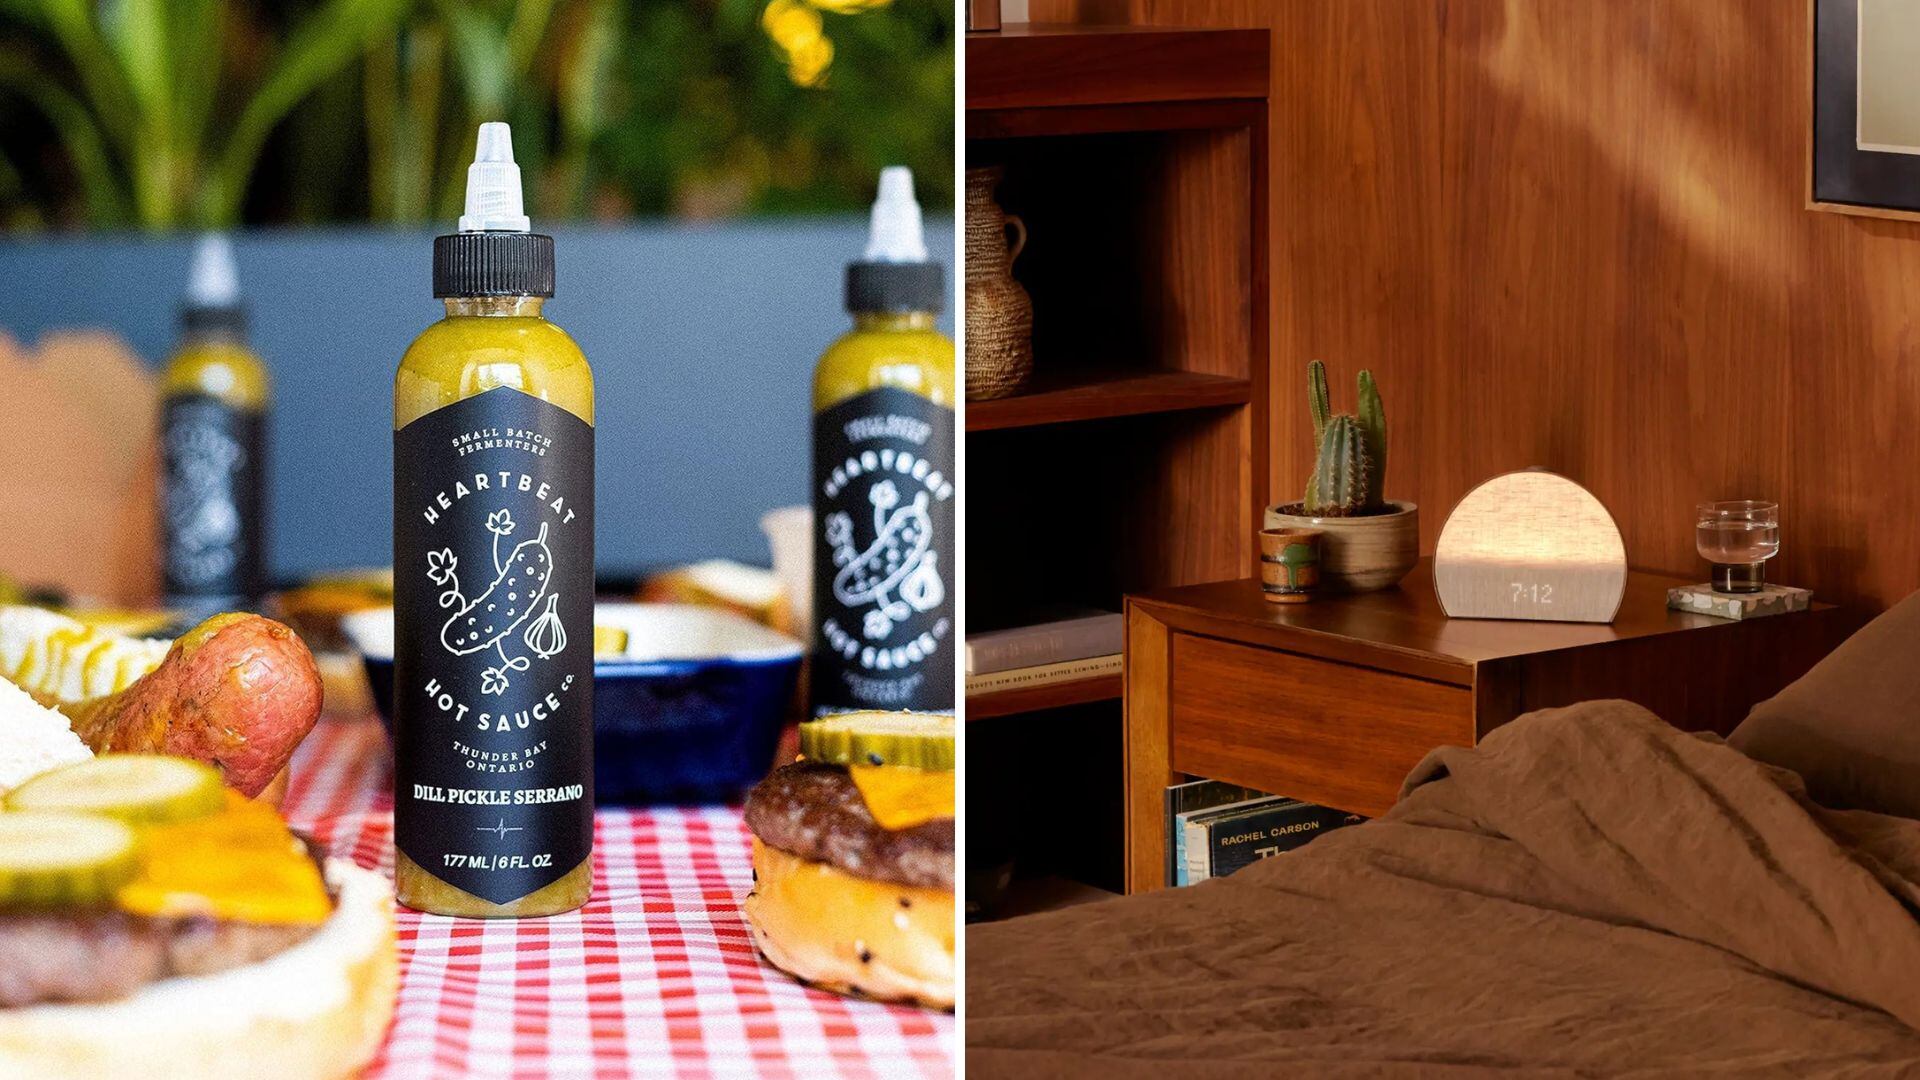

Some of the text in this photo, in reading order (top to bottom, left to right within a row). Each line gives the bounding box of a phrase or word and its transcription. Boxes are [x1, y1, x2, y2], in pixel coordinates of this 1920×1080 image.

[452, 428, 552, 448] SMALL BATCH
[458, 438, 546, 457] FERMENTERS
[423, 471, 575, 526] HEARTBEAT
[1511, 583, 1552, 603] 7:12
[424, 678, 469, 722] HOT
[477, 692, 561, 732] SAUCE
[452, 740, 549, 762] THUNDER BAY
[465, 759, 535, 773] ONTARIO
[413, 783, 583, 806] DILL PICKLE SERRANO
[1221, 821, 1320, 846] RACHEL CARSON
[443, 854, 468, 868] 177
[468, 855, 490, 869] ML
[498, 855, 509, 869] 6
[531, 853, 553, 868] OZ
